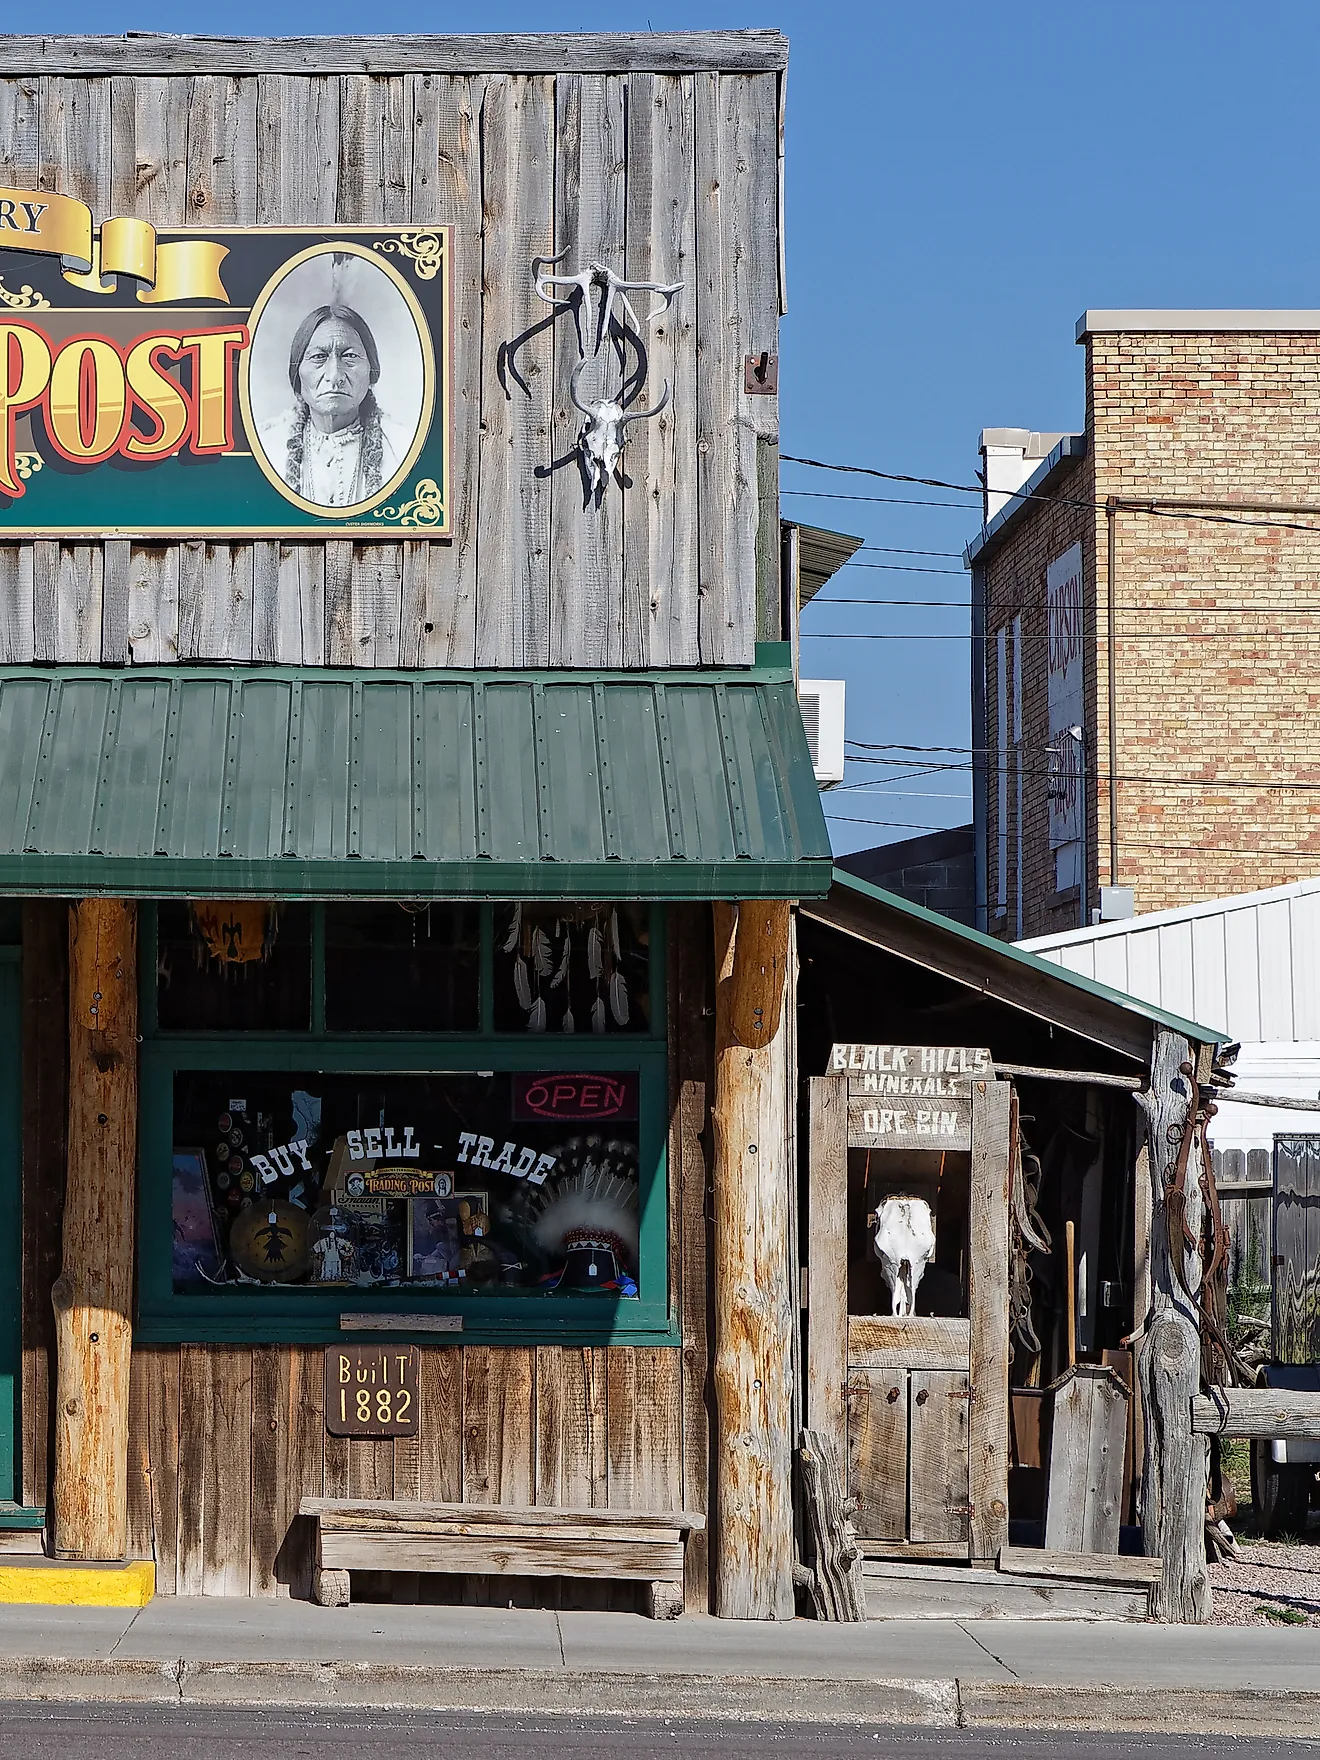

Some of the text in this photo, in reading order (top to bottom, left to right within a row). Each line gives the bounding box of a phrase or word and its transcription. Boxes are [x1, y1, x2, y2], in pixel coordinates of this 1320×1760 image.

[832, 1045, 991, 1075] BLACK HILLS
[525, 1085, 626, 1109] OPEN
[863, 1109, 958, 1136] ORE BIN
[249, 1138, 312, 1186] BUY
[346, 1126, 421, 1161] SELL
[456, 1132, 558, 1186] TRADE
[365, 1178, 435, 1195] TRADING POST
[340, 1388, 412, 1424] 1882
